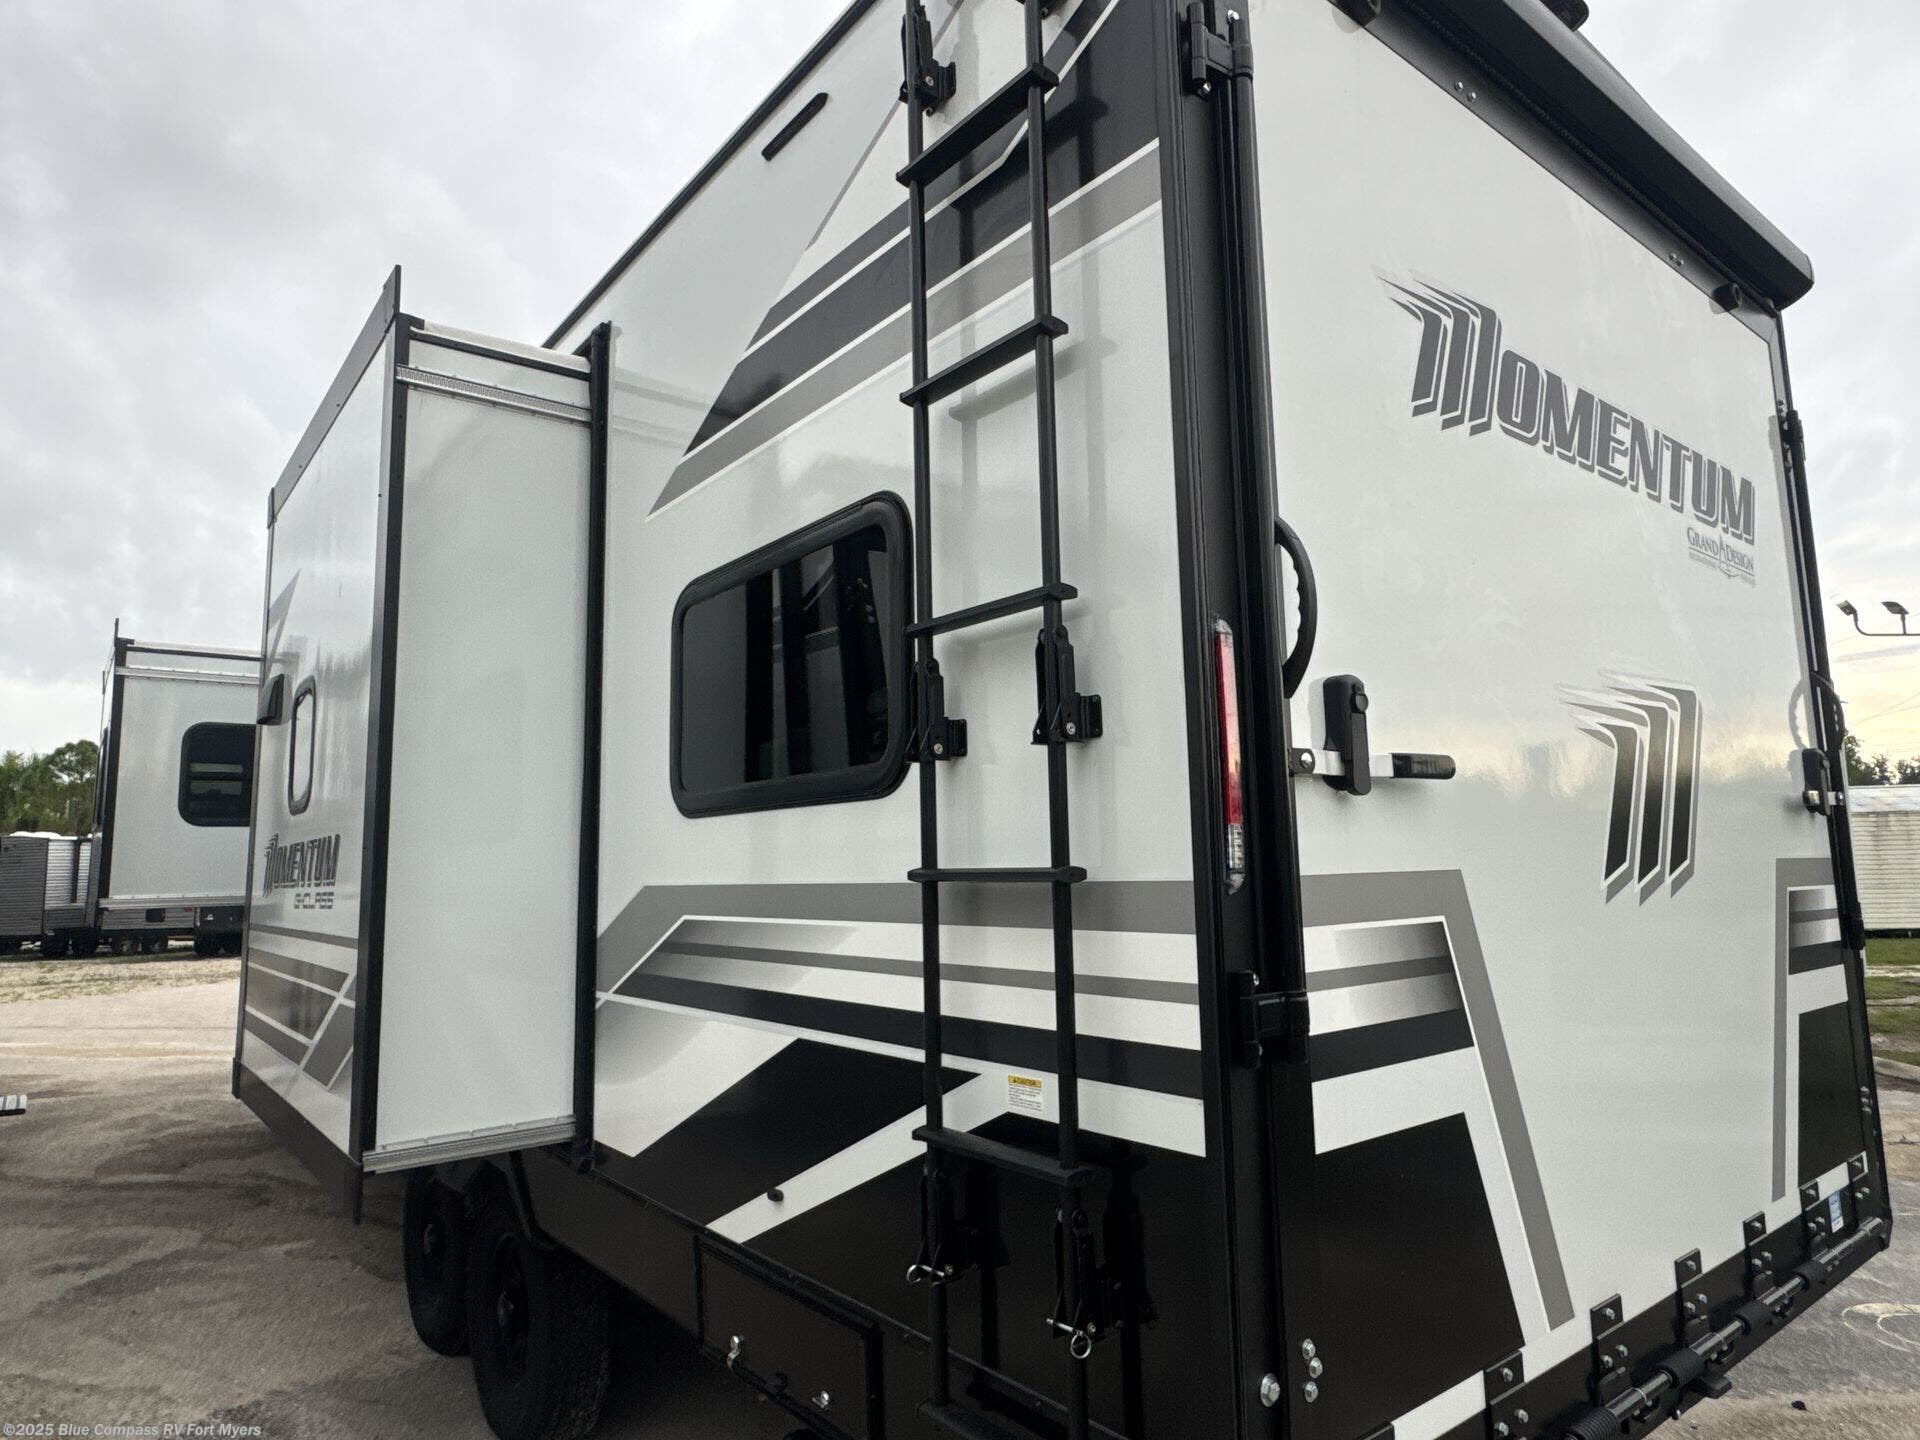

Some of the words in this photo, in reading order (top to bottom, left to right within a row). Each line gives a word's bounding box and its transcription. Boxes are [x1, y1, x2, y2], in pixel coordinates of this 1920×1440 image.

[1372, 266, 1755, 546] MOMENTUM
[1687, 526, 1719, 556] GRAND
[1725, 543, 1754, 572] DESIGN
[263, 833, 341, 897] MOMENTUM
